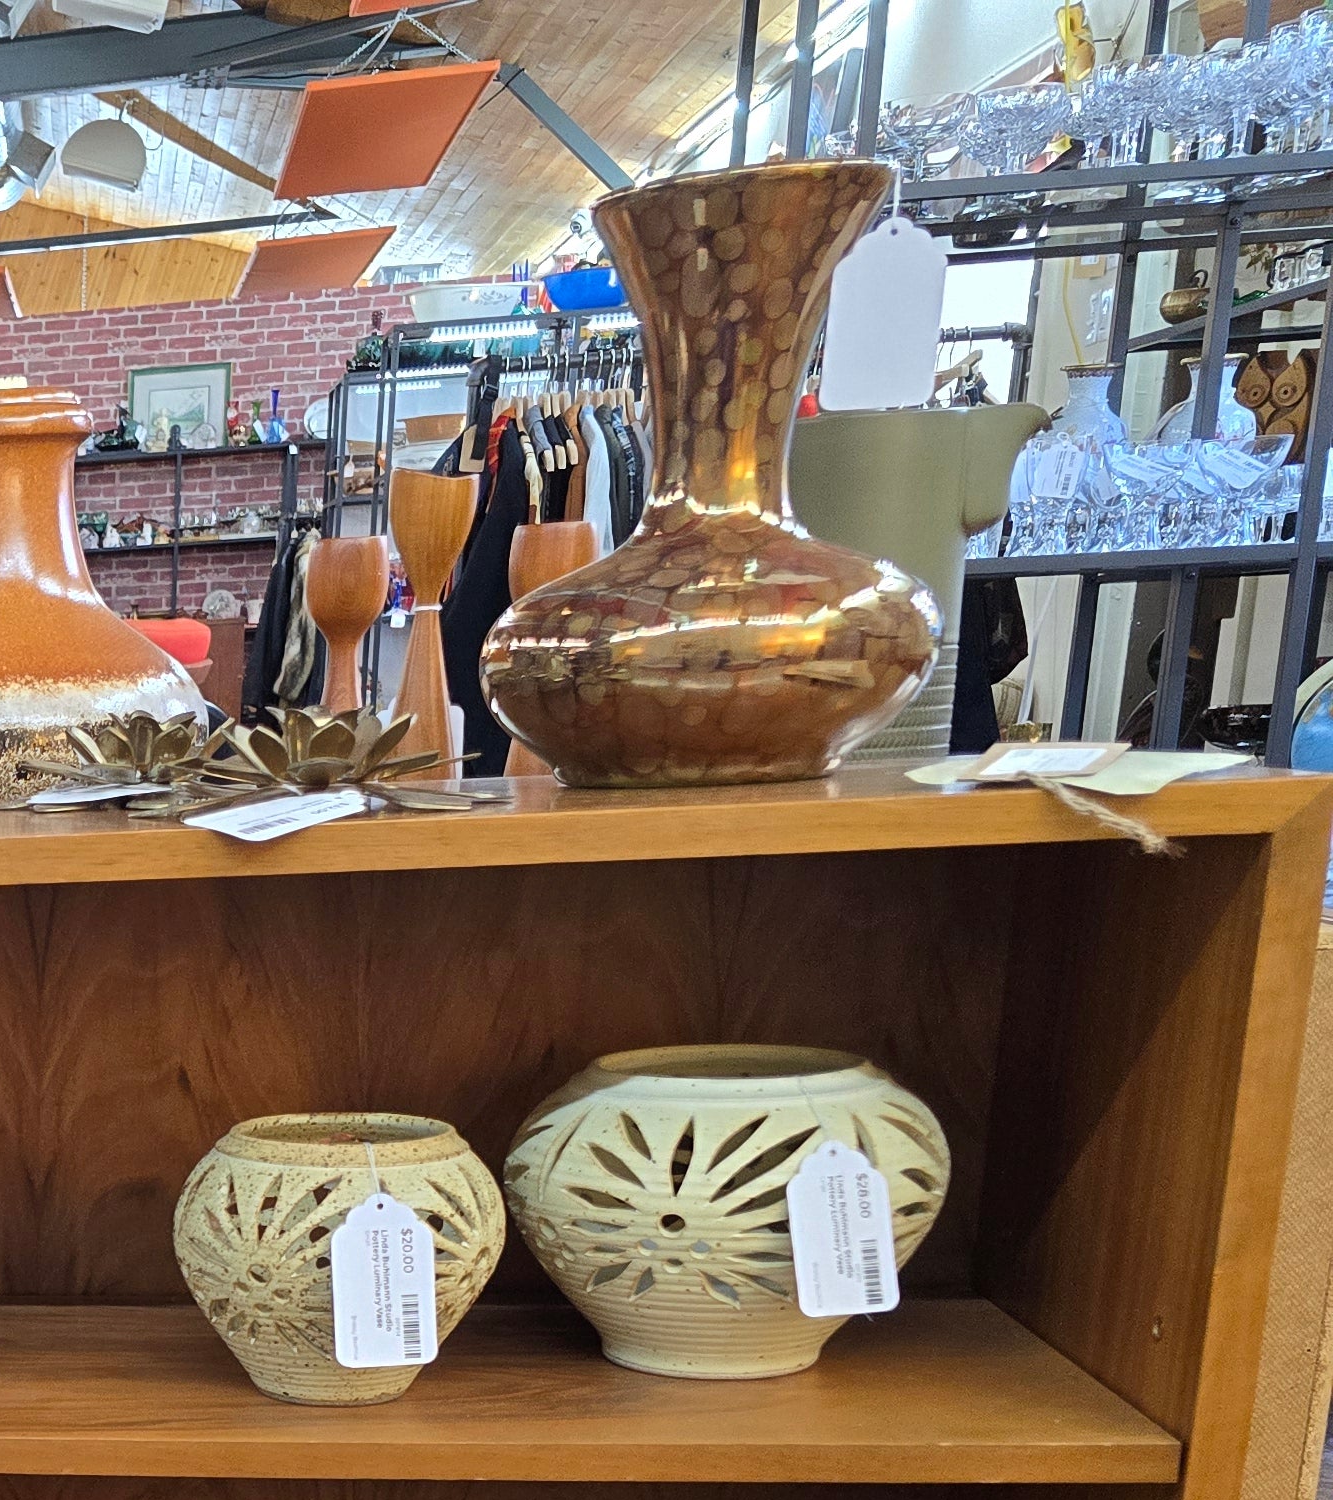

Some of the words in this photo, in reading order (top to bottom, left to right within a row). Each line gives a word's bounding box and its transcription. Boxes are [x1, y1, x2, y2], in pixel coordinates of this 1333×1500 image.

[825, 1174, 837, 1209] Pottery
[835, 1174, 845, 1199] Linda
[380, 1228, 389, 1254] Linda
[829, 1209, 842, 1252] Luminary
[838, 1201, 850, 1247] Buhlmann
[369, 1229, 380, 1263] Pottery
[399, 1227, 415, 1274] $20.00
[381, 1255, 391, 1301] Buhlmann
[834, 1253, 844, 1275] Vase
[843, 1248, 854, 1279] Studio
[371, 1264, 382, 1306] Luminary
[375, 1307, 383, 1329] Vase
[384, 1303, 393, 1332] Studio
